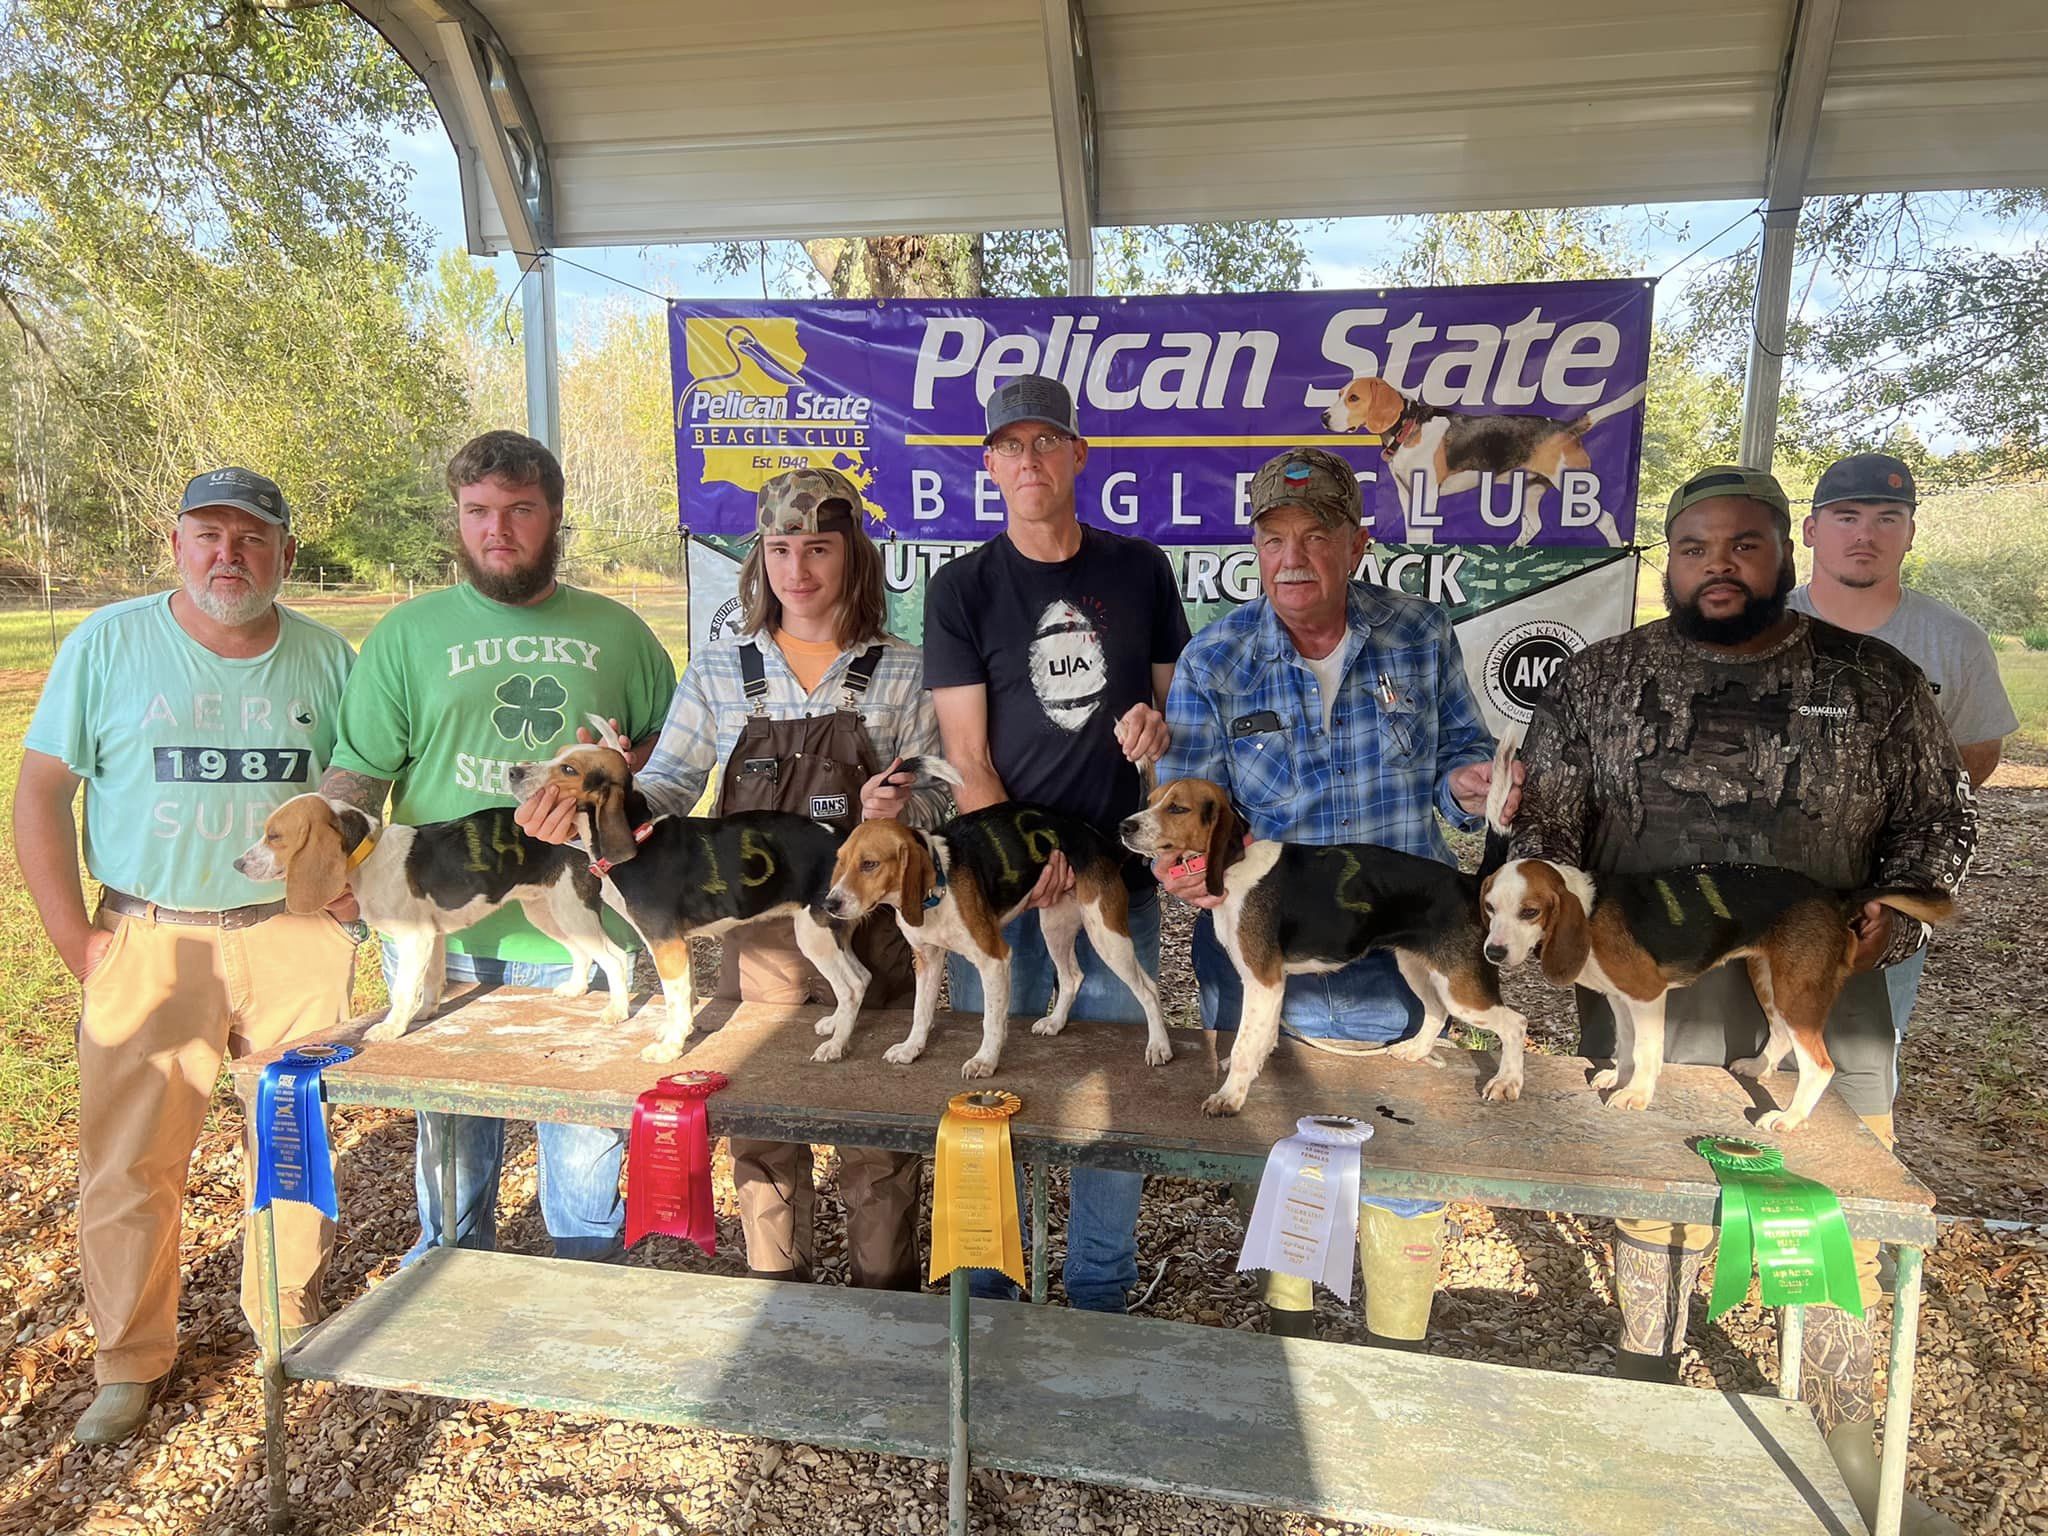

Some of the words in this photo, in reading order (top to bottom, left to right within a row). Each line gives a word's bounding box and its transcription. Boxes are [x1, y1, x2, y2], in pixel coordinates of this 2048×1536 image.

[911, 315, 1280, 411] Pelican
[1304, 307, 1621, 408] State
[691, 391, 788, 419] Pelican
[795, 392, 871, 420] State
[694, 428, 788, 445] BEAGLE
[804, 430, 866, 446] CLUB
[777, 456, 809, 468] 1948
[912, 470, 1253, 527] BEGLE
[447, 635, 601, 678] LUCKY
[1489, 628, 1533, 679] AMERICAN
[1535, 625, 1580, 649] KENNEL
[1810, 705, 1848, 715] MAGELLAN
[167, 749, 300, 780] 1987
[813, 798, 845, 812] DAN'S
[697, 828, 776, 895] 15
[980, 809, 1060, 883] 16
[1654, 873, 1733, 926] 11
